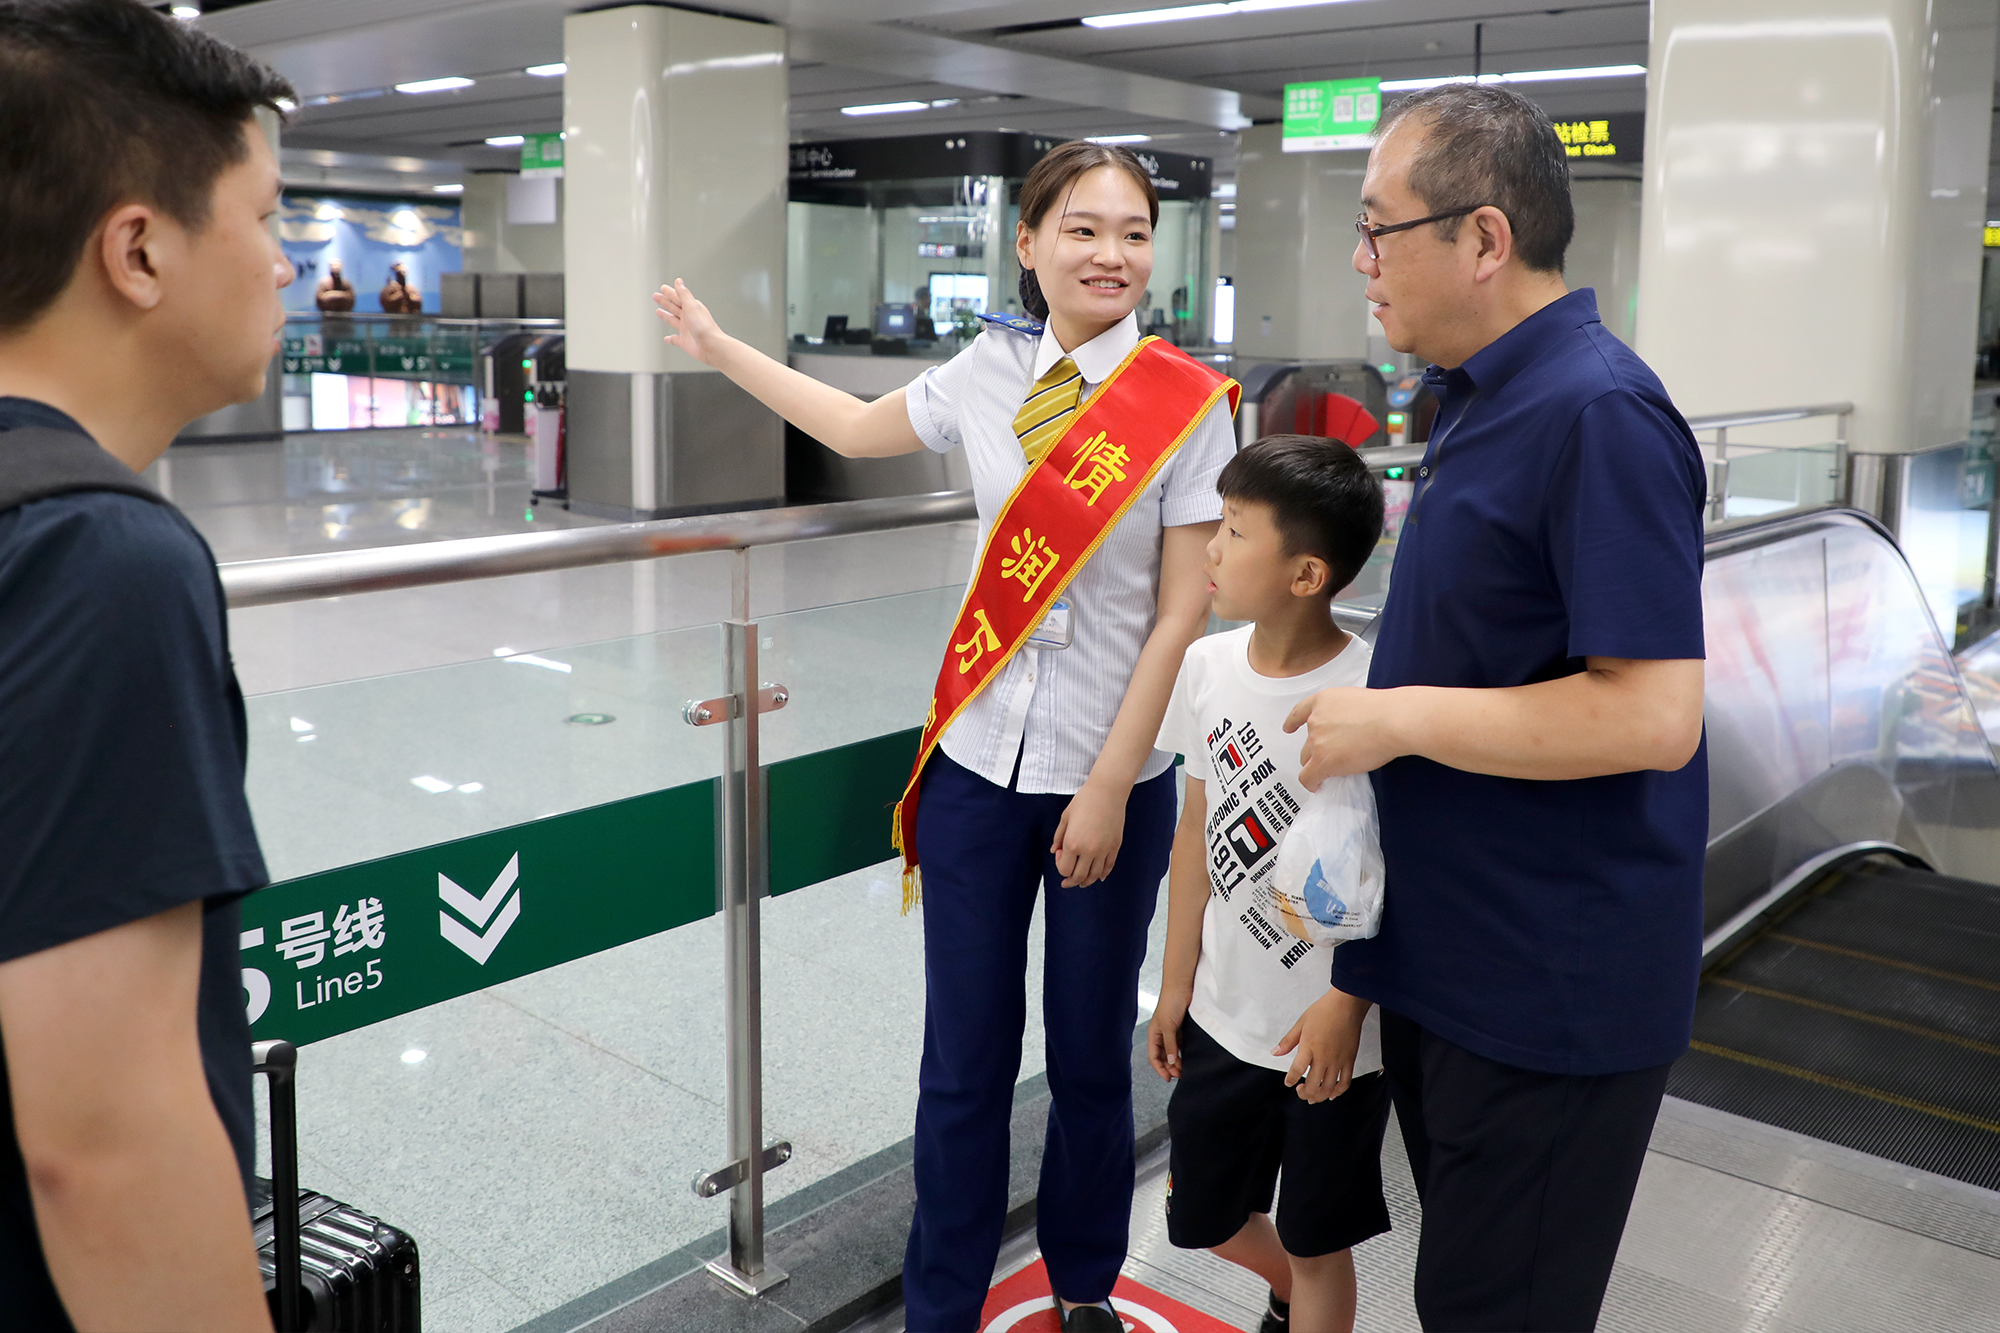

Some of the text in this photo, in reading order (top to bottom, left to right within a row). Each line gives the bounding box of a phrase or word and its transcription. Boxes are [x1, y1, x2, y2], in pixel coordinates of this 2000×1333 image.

[1583, 143, 1616, 156] Check
[1207, 718, 1232, 751] FILA
[1237, 721, 1263, 760] 1911
[1212, 791, 1240, 830] ICONIC
[1239, 758, 1277, 798] F-BOX
[1264, 790, 1276, 802] OF
[1273, 782, 1301, 816] SIGNATU
[1256, 797, 1285, 834] HERITAGE
[1211, 832, 1247, 894] 1911
[1250, 858, 1277, 884] SIGNATURE
[1210, 869, 1230, 902] ICONIC
[1239, 914, 1251, 926] OF
[1247, 923, 1272, 950] ITALIAN
[1247, 906, 1283, 945] SIGNATURE
[1280, 939, 1315, 970] HERIT
[296, 958, 383, 1010] Line5
